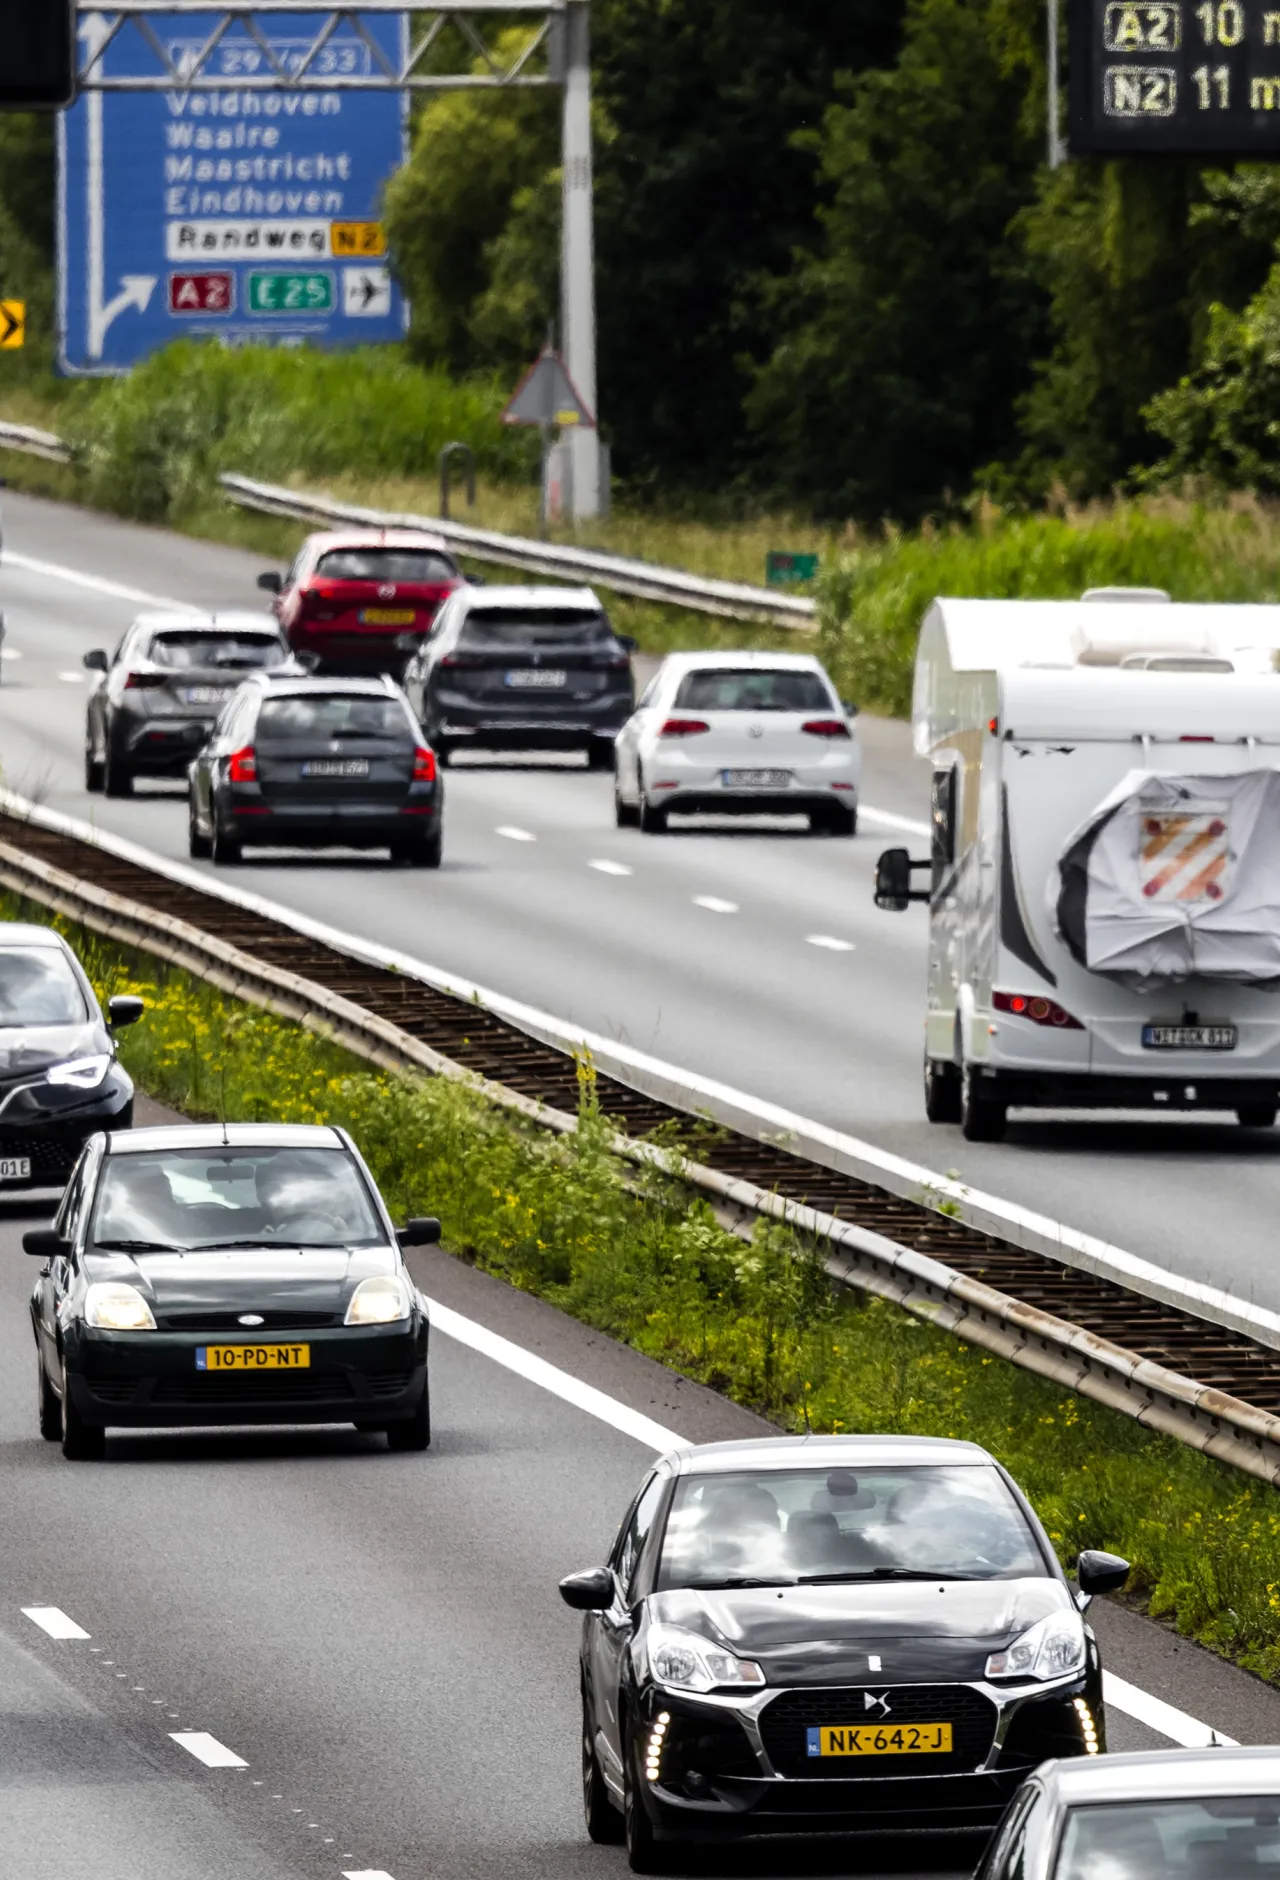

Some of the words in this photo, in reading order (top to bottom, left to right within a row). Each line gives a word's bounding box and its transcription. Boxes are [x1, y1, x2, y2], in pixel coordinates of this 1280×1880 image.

[1114, 8, 1170, 46] A2
[1195, 1, 1244, 46] 10
[223, 49, 261, 73] 29
[317, 49, 357, 73] 33
[1113, 73, 1166, 110] N2
[1191, 64, 1229, 110] 11
[166, 90, 341, 117] Veldhoven
[166, 121, 280, 150] Waalre
[166, 153, 351, 182] Maastricht
[168, 184, 343, 214] Eindhoven
[177, 225, 326, 252] Randweg
[338, 230, 380, 250] N2
[177, 277, 226, 308] A2
[257, 278, 327, 306] E25
[214, 1347, 302, 1366] 10-PD-NT
[829, 1727, 943, 1752] NK-642-J
